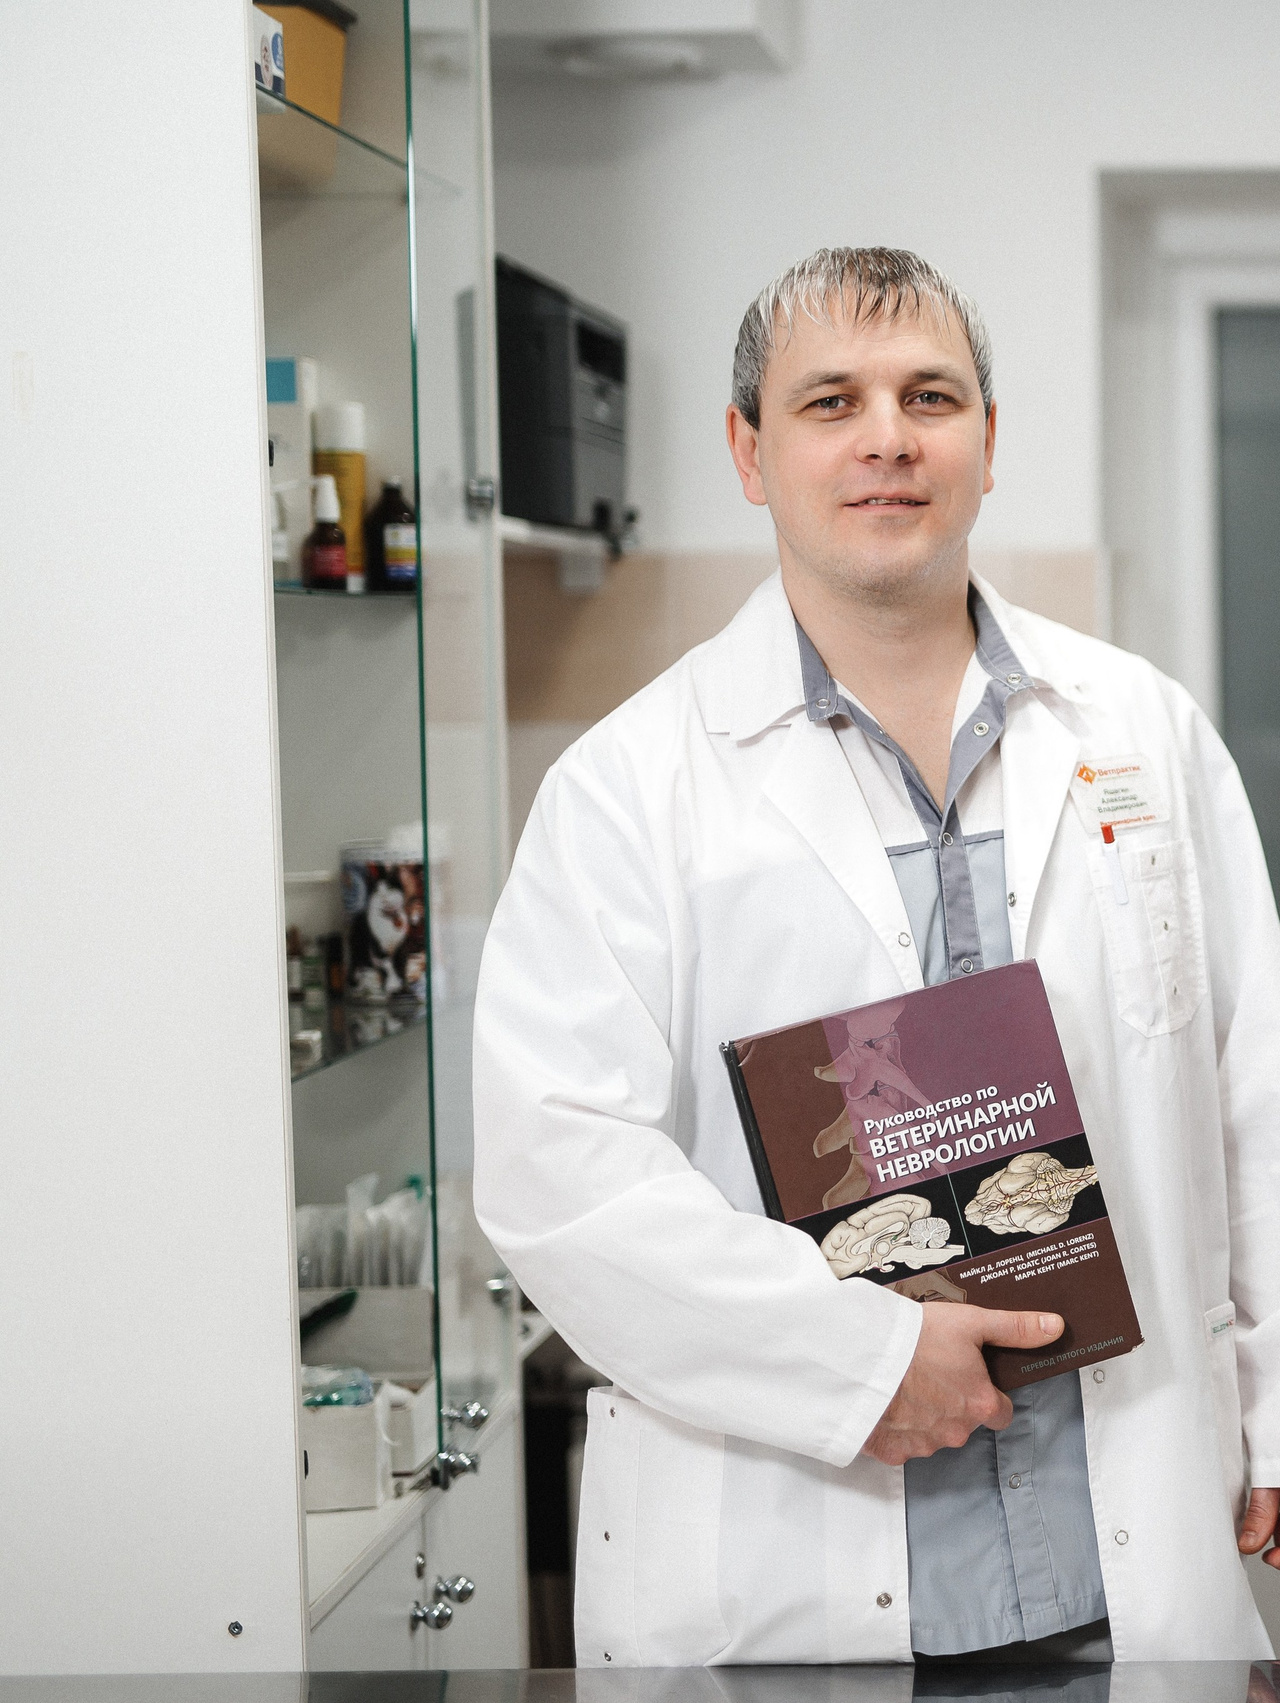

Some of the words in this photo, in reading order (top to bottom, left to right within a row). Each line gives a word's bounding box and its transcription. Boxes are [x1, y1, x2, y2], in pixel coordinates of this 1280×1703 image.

[1097, 765, 1141, 777] Ветпрактик
[863, 1093, 973, 1136] Руководство
[976, 1085, 999, 1101] по
[869, 1081, 1057, 1159] ВЕТЕРИНАРНОЙ
[876, 1118, 1037, 1183] НЕВРОЛОГИИ
[959, 1265, 987, 1280] МАЙКЛ
[987, 1264, 995, 1273] Д.
[995, 1254, 1024, 1269] ЛОРЕНЦ
[1026, 1245, 1058, 1260] (MICHAEL
[1066, 1232, 1095, 1246] LORENZ)
[980, 1268, 1009, 1284] ДЖОАН
[1016, 1260, 1040, 1271] КОАТС
[1041, 1252, 1062, 1265] (JOAN
[1062, 1250, 1069, 1258] R.
[1070, 1242, 1097, 1255] COATES)
[1014, 1270, 1036, 1282] МАРК
[1037, 1264, 1055, 1275] КЕНТ
[1057, 1257, 1079, 1270] (MARC
[1079, 1250, 1100, 1262] KENT)
[1020, 1357, 1056, 1374] ПЕРЕВОД
[1056, 1348, 1086, 1363] ПЯТОГО
[1087, 1335, 1124, 1353] ИЗДАНИЯ
